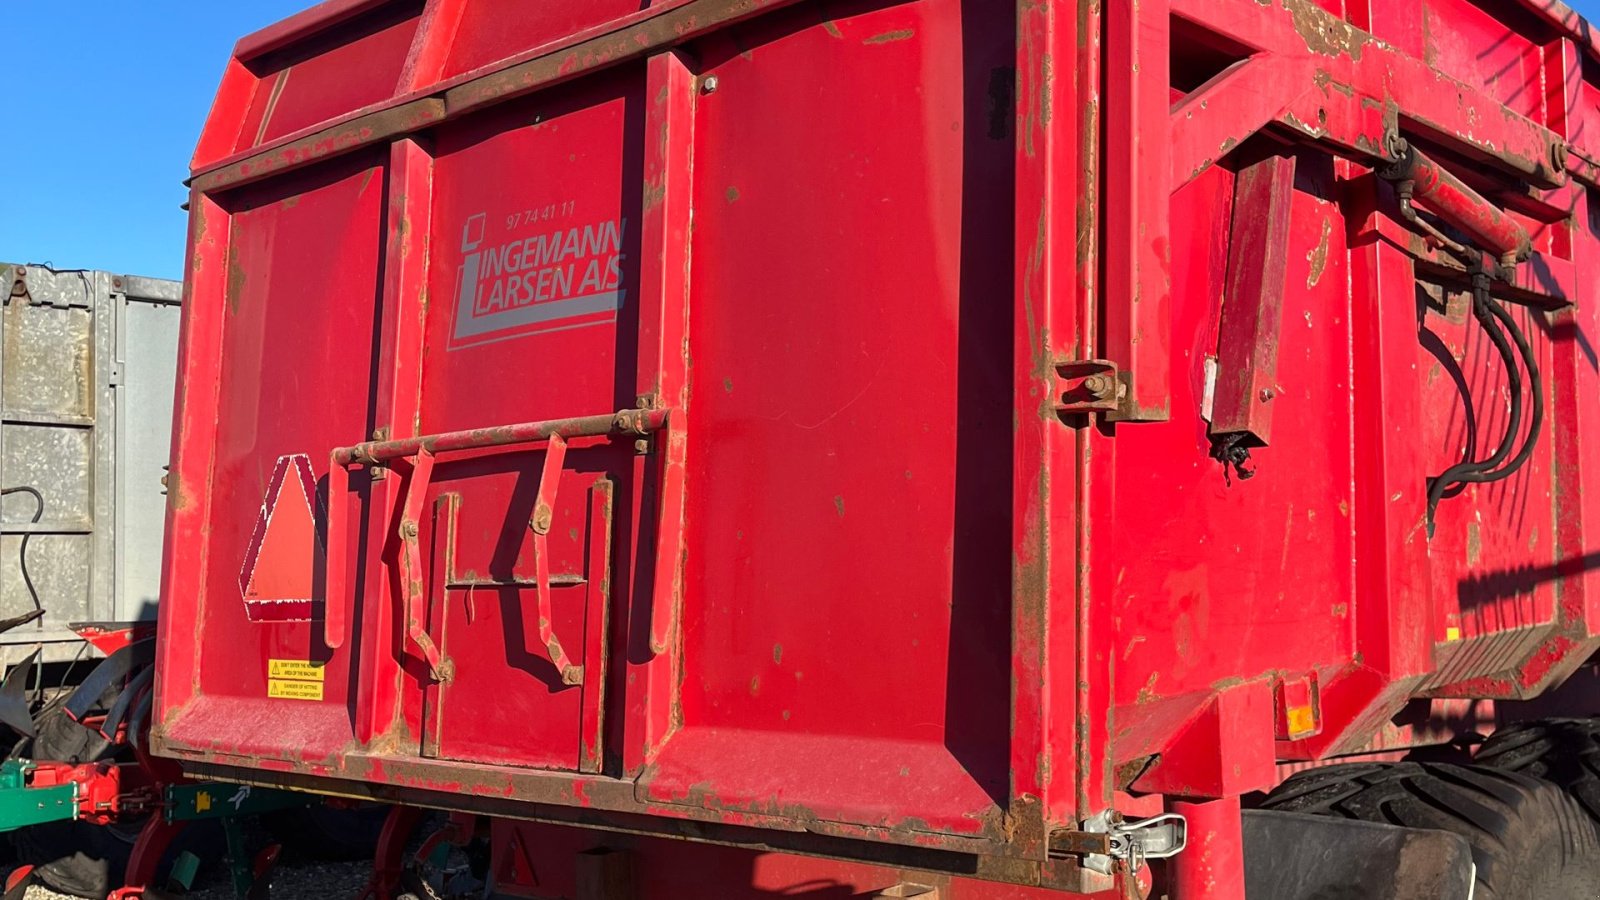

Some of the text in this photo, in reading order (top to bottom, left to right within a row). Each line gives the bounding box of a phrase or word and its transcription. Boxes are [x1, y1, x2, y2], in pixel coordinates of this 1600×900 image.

[506, 200, 575, 230] 97 74 41 11
[476, 254, 626, 315] LARSEN A/S
